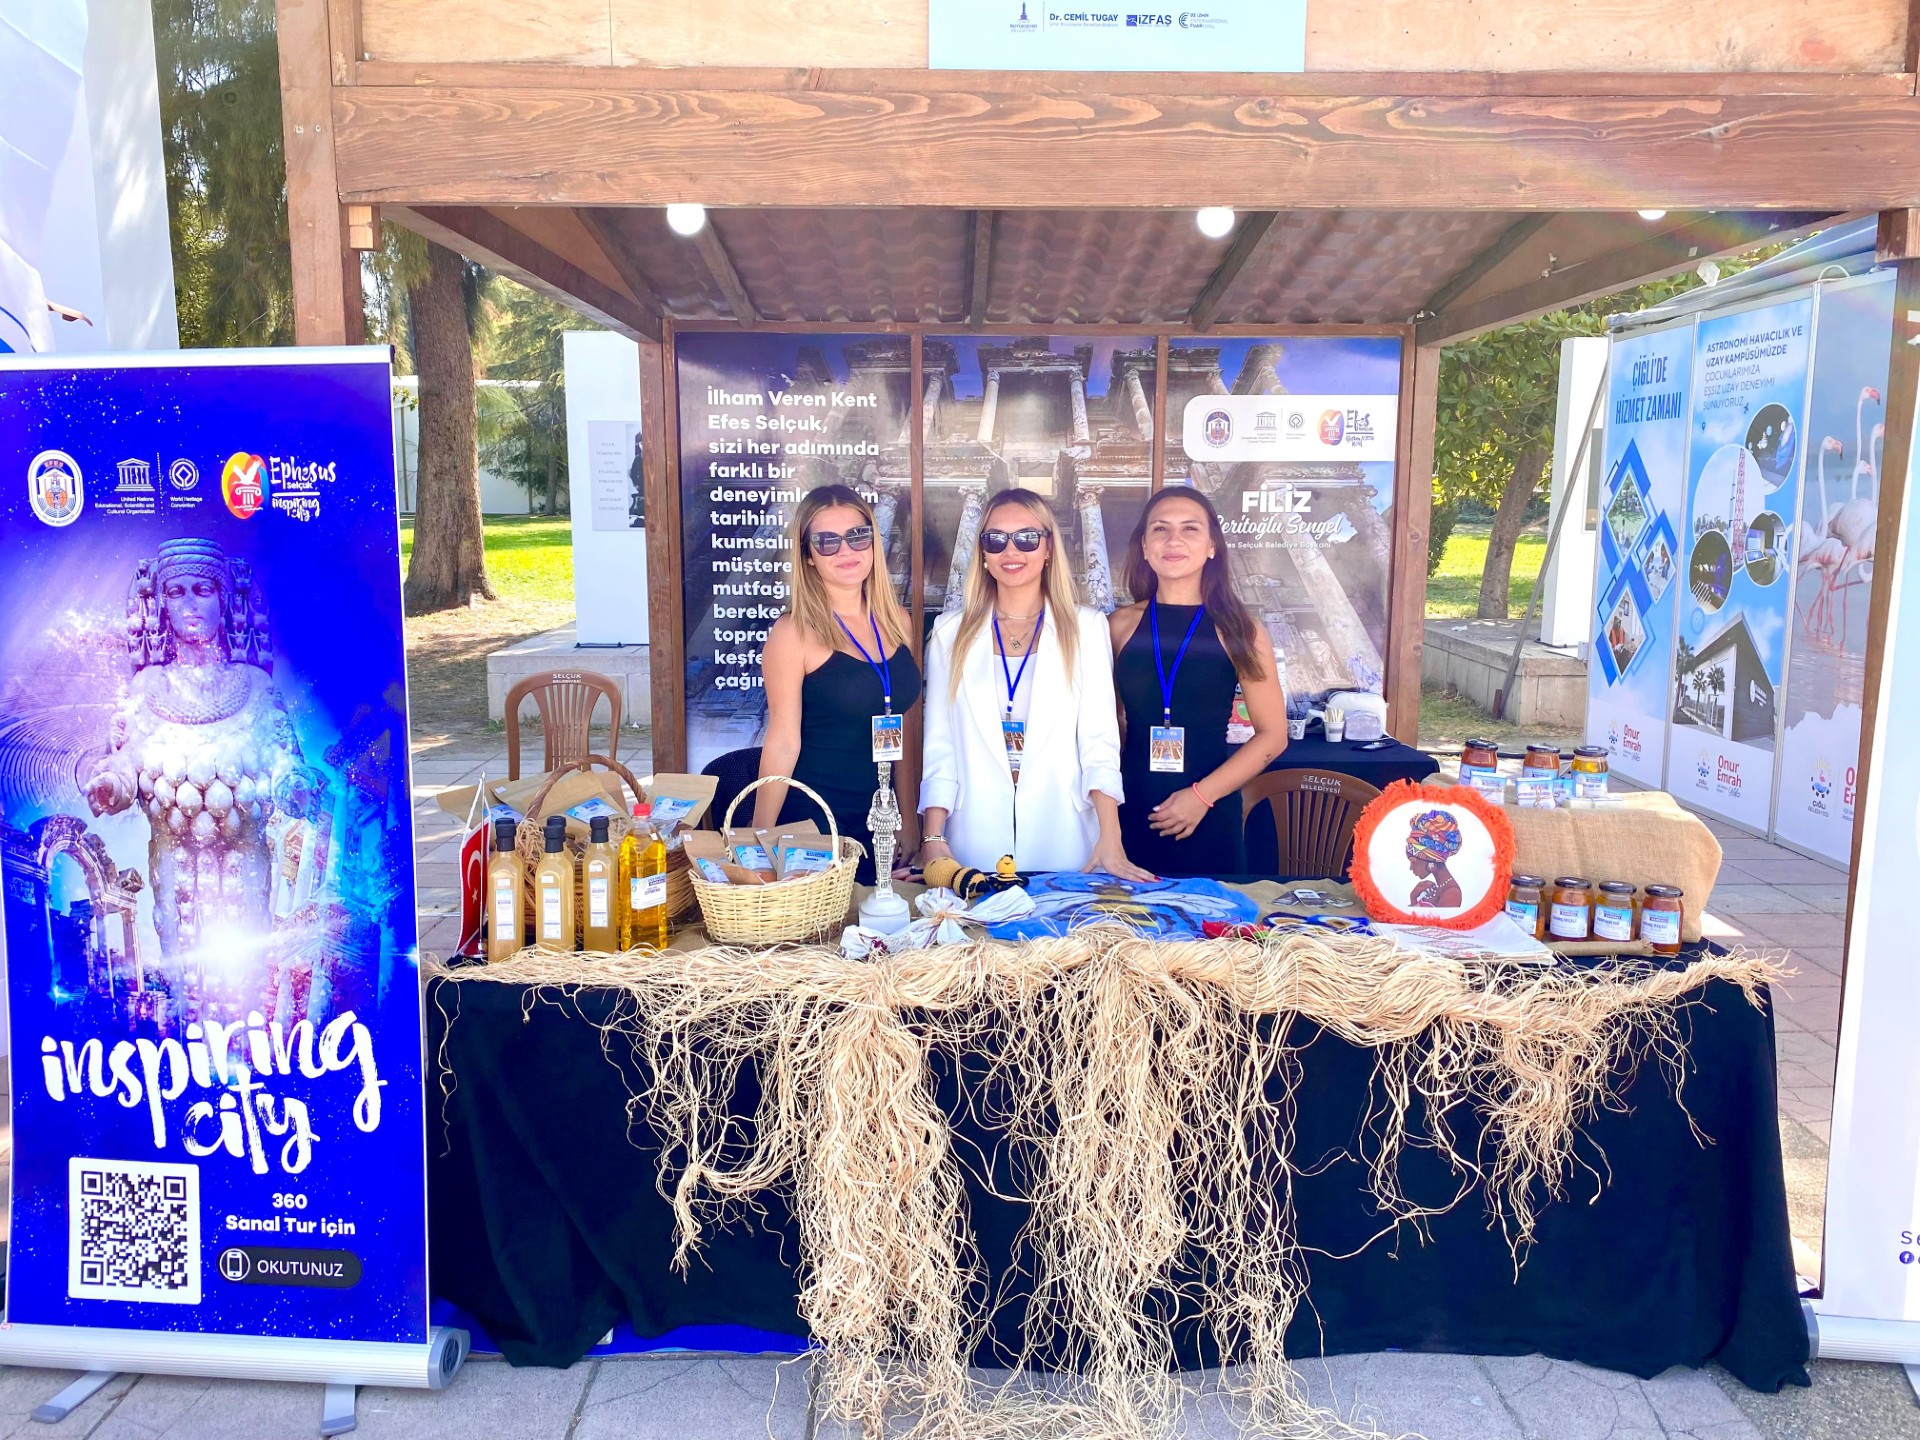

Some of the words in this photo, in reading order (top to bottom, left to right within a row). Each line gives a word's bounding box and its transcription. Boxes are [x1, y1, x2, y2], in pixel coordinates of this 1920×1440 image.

[1049, 13, 1062, 21] Dr.
[1063, 11, 1089, 21] CEMİL
[1090, 14, 1119, 22] TUGAY
[1706, 333, 1749, 354] ASTRONOMİ
[1749, 327, 1791, 346] HAVACILIK
[1791, 325, 1803, 337] VE
[1705, 355, 1724, 368] UZAY
[1724, 343, 1788, 365] KAMPÜSÜMÜZDE
[1632, 352, 1668, 392] ÇİĞLİ'DE
[1705, 364, 1761, 383] ÇOCUKLARIMIZA
[707, 385, 764, 406] İlham
[768, 390, 827, 408] Veren
[831, 391, 878, 408] Kent
[1722, 382, 1740, 394] UZAY
[1615, 393, 1646, 425] HİZMET
[1646, 391, 1682, 422] ZAMANI
[1703, 396, 1744, 411] SUNUYORUZ
[707, 413, 750, 430] Efes
[755, 414, 828, 434] Selçuk,
[708, 438, 742, 454] sizi
[746, 438, 781, 455] her
[784, 439, 879, 456] adımında
[269, 455, 337, 490] Ephesus
[709, 461, 763, 479] farklı
[767, 462, 796, 479] bir
[271, 497, 321, 518] inspiring
[1241, 483, 1313, 513] FİLİZ
[710, 509, 789, 529] tarihini,
[1237, 541, 1264, 550] Selçuk
[1265, 541, 1299, 550] Belediye
[712, 556, 793, 576] müştere
[712, 580, 791, 600] mutfağı
[713, 626, 773, 645] topra
[714, 649, 763, 668] keşfe
[552, 673, 582, 681] SELÇUK
[714, 672, 765, 691] çağır
[1623, 723, 1641, 741] Onur
[1623, 736, 1642, 753] Emrah
[1718, 754, 1740, 773] Onur
[1302, 774, 1342, 787] SELÇUK
[1717, 768, 1742, 789] Emrah
[1845, 766, 1856, 787] O
[1300, 783, 1341, 794] BELEDİYESİ
[40, 1010, 389, 1149] inspiring
[180, 1062, 321, 1175] city
[271, 1192, 309, 1210] 360
[225, 1214, 281, 1232] Sanal
[283, 1217, 318, 1234] Tur
[320, 1217, 356, 1238] için
[1900, 1230, 1920, 1247] S
[256, 1259, 345, 1277] OKUTUNUZ
